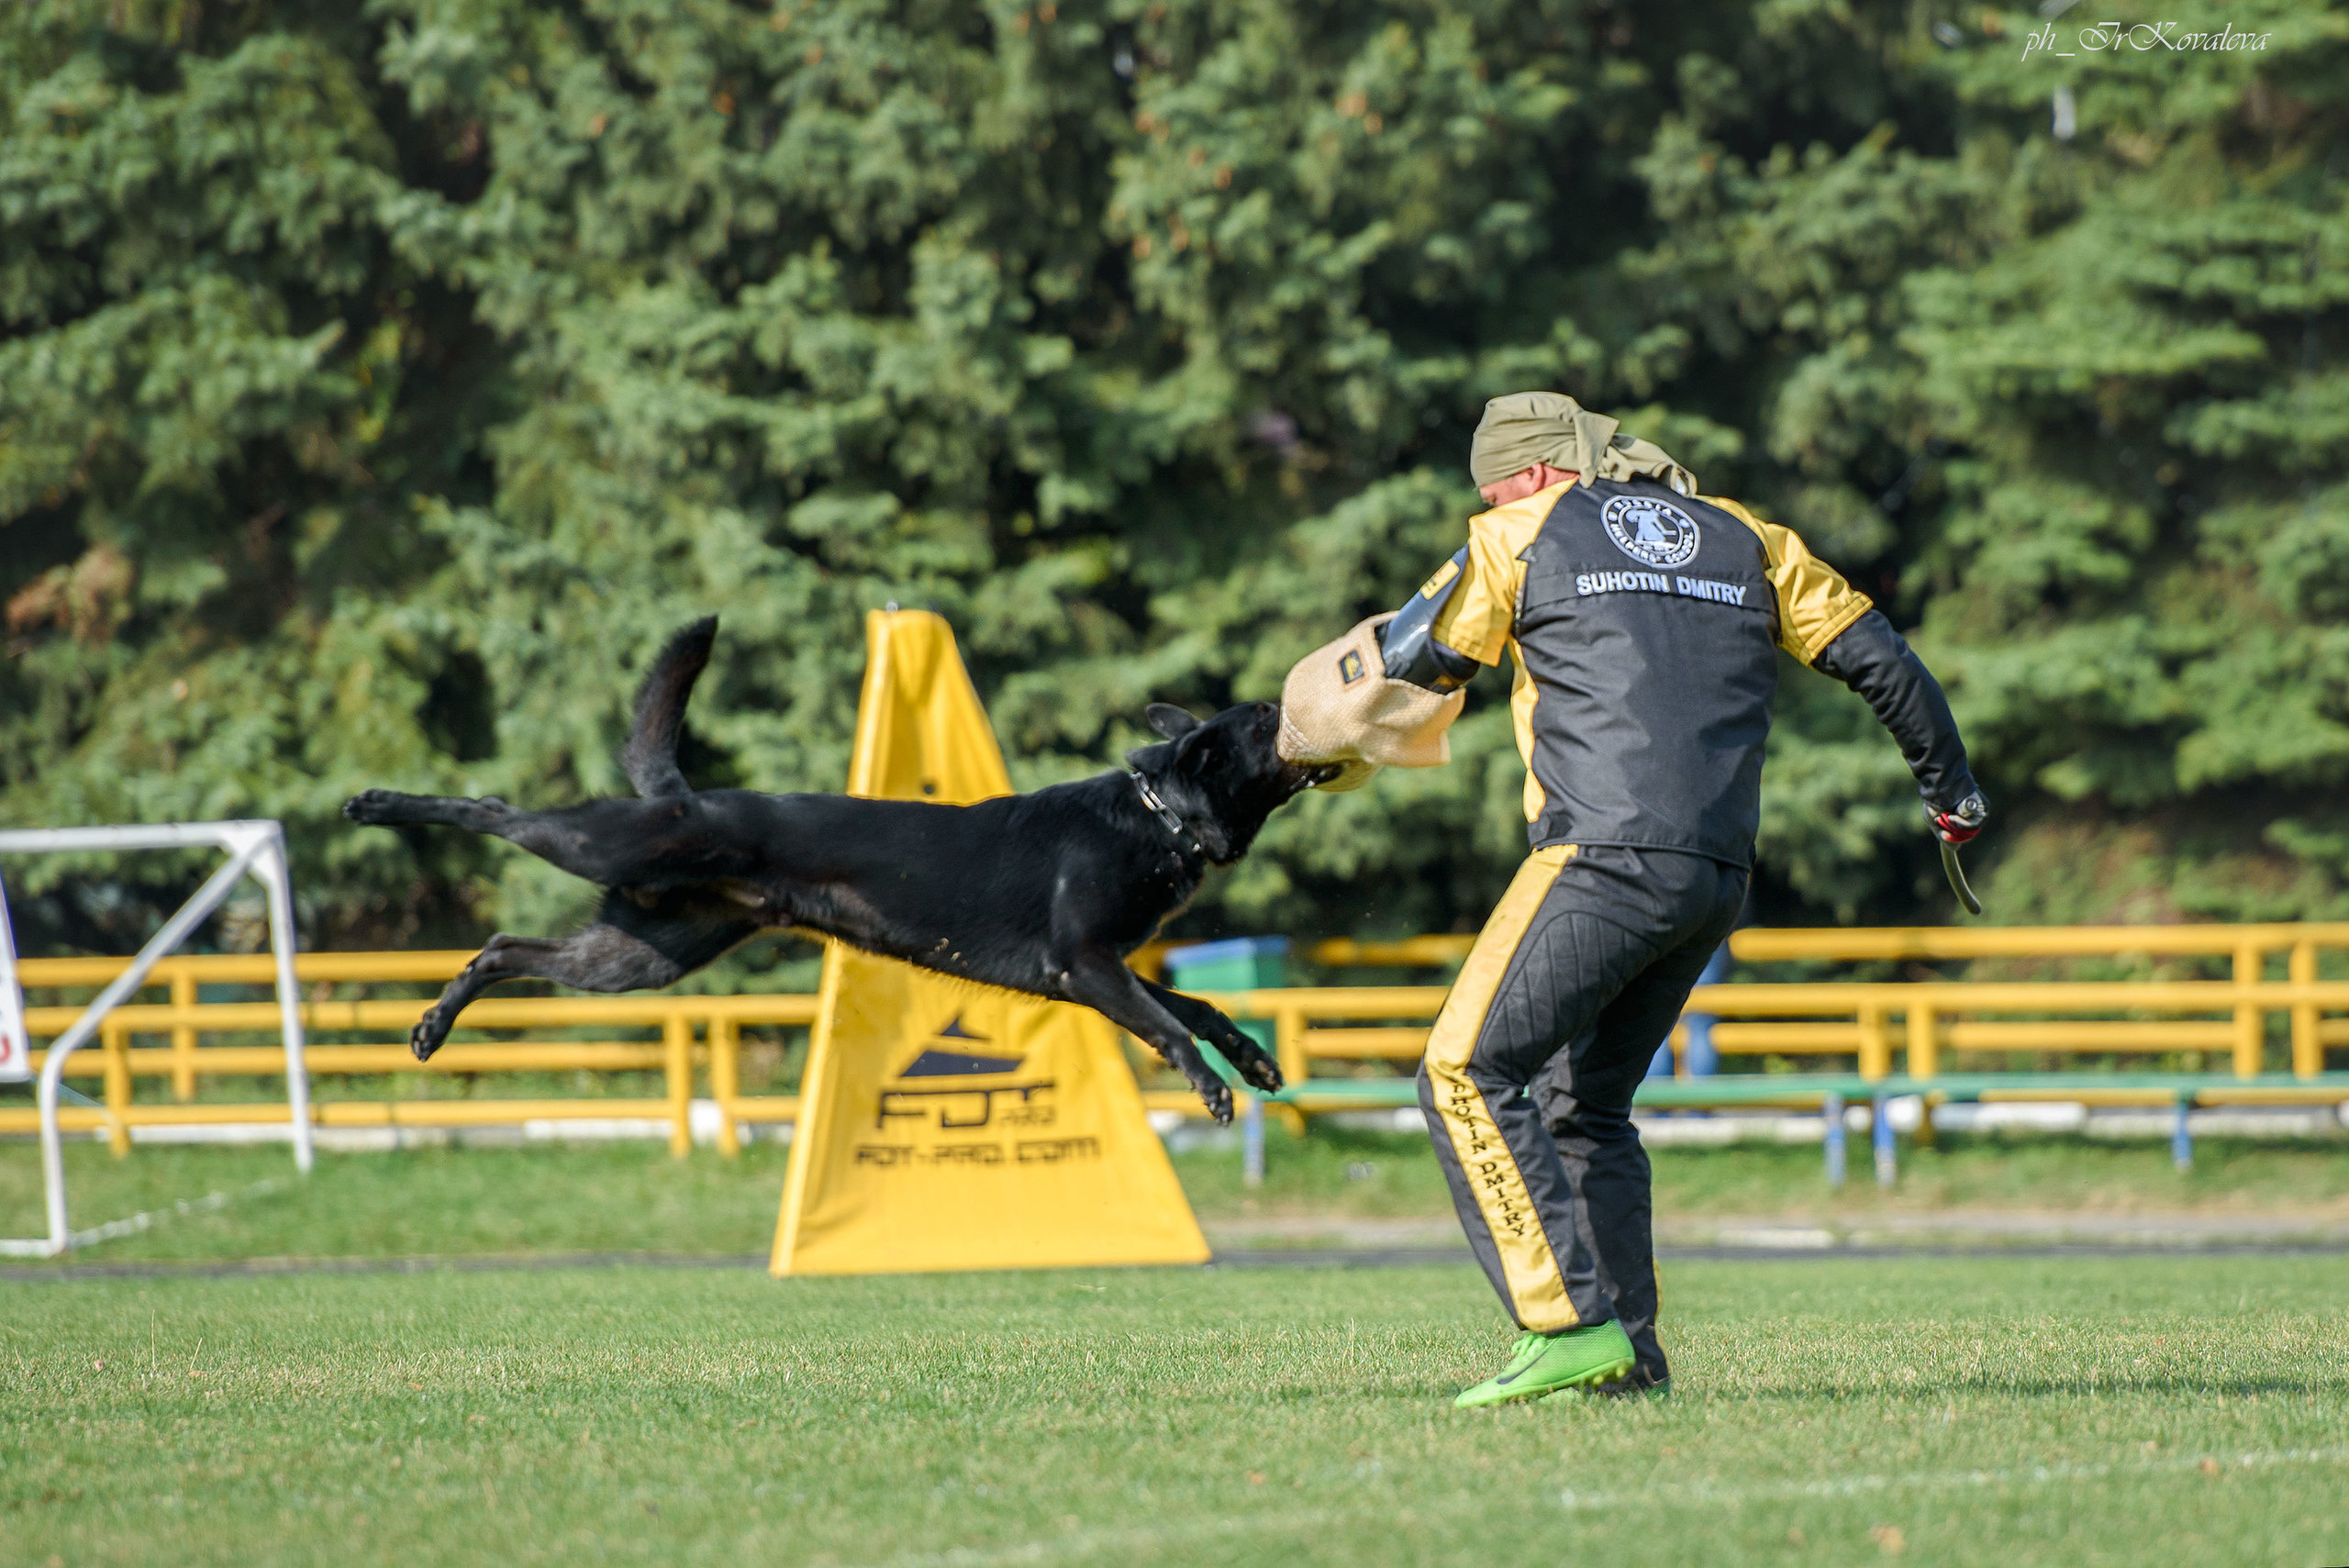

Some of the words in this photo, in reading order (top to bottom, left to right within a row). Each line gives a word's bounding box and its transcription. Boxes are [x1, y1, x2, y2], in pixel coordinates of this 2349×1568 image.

[1575, 571, 1671, 596] SUHOTIN
[1675, 575, 1747, 606] DMITRY
[1479, 1162, 1526, 1237] DMITRY
